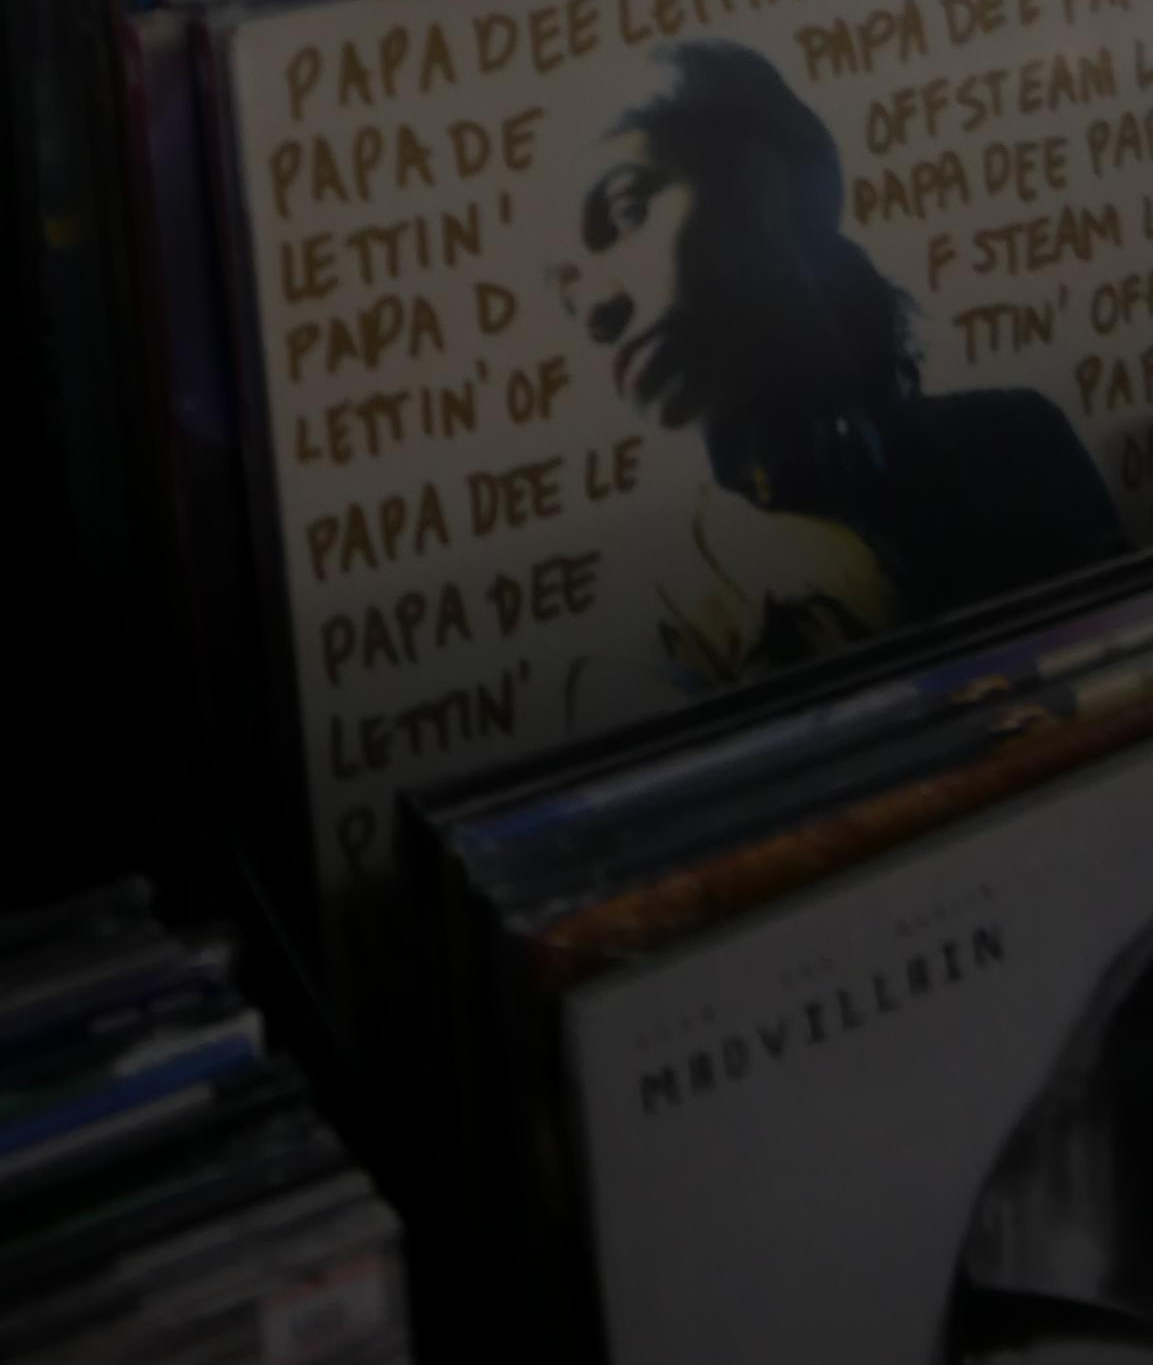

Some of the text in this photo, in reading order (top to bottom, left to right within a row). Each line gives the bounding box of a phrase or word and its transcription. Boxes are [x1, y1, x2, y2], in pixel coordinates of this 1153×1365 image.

[284, 21, 458, 121] PAPA
[269, 106, 545, 219] PAPA DE
[853, 149, 971, 225] PAPA
[984, 135, 1069, 202] DEE
[280, 190, 512, 304] LETTIN'
[972, 203, 1123, 277] STEAM
[284, 281, 517, 382] PAPA D
[295, 355, 572, 467] LETTIN' OF
[306, 434, 645, 583] PAPA DEE LE
[320, 549, 602, 688] PAPA DEE
[328, 659, 532, 783] LETTIN'
